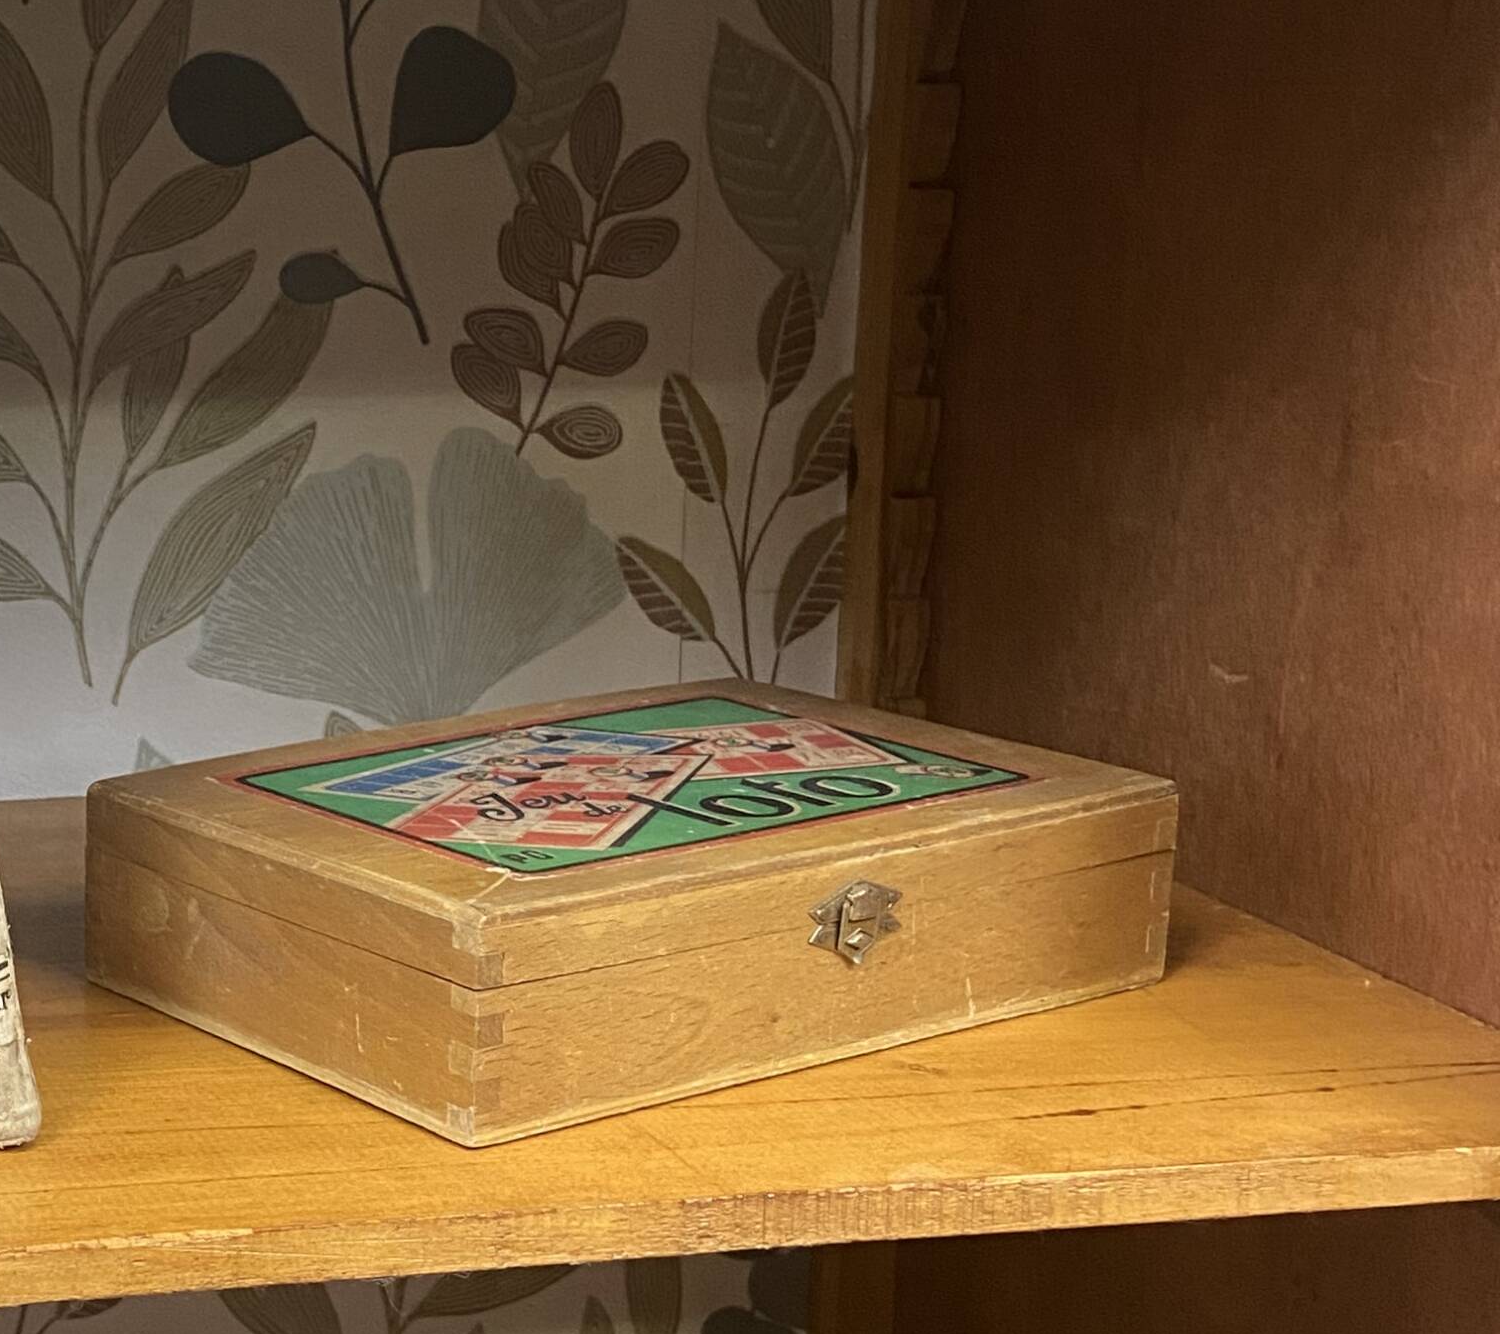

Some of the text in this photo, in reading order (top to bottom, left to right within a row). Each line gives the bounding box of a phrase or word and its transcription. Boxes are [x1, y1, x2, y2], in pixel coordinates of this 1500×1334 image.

[470, 787, 589, 822] Jeu
[583, 773, 896, 827] de loto
